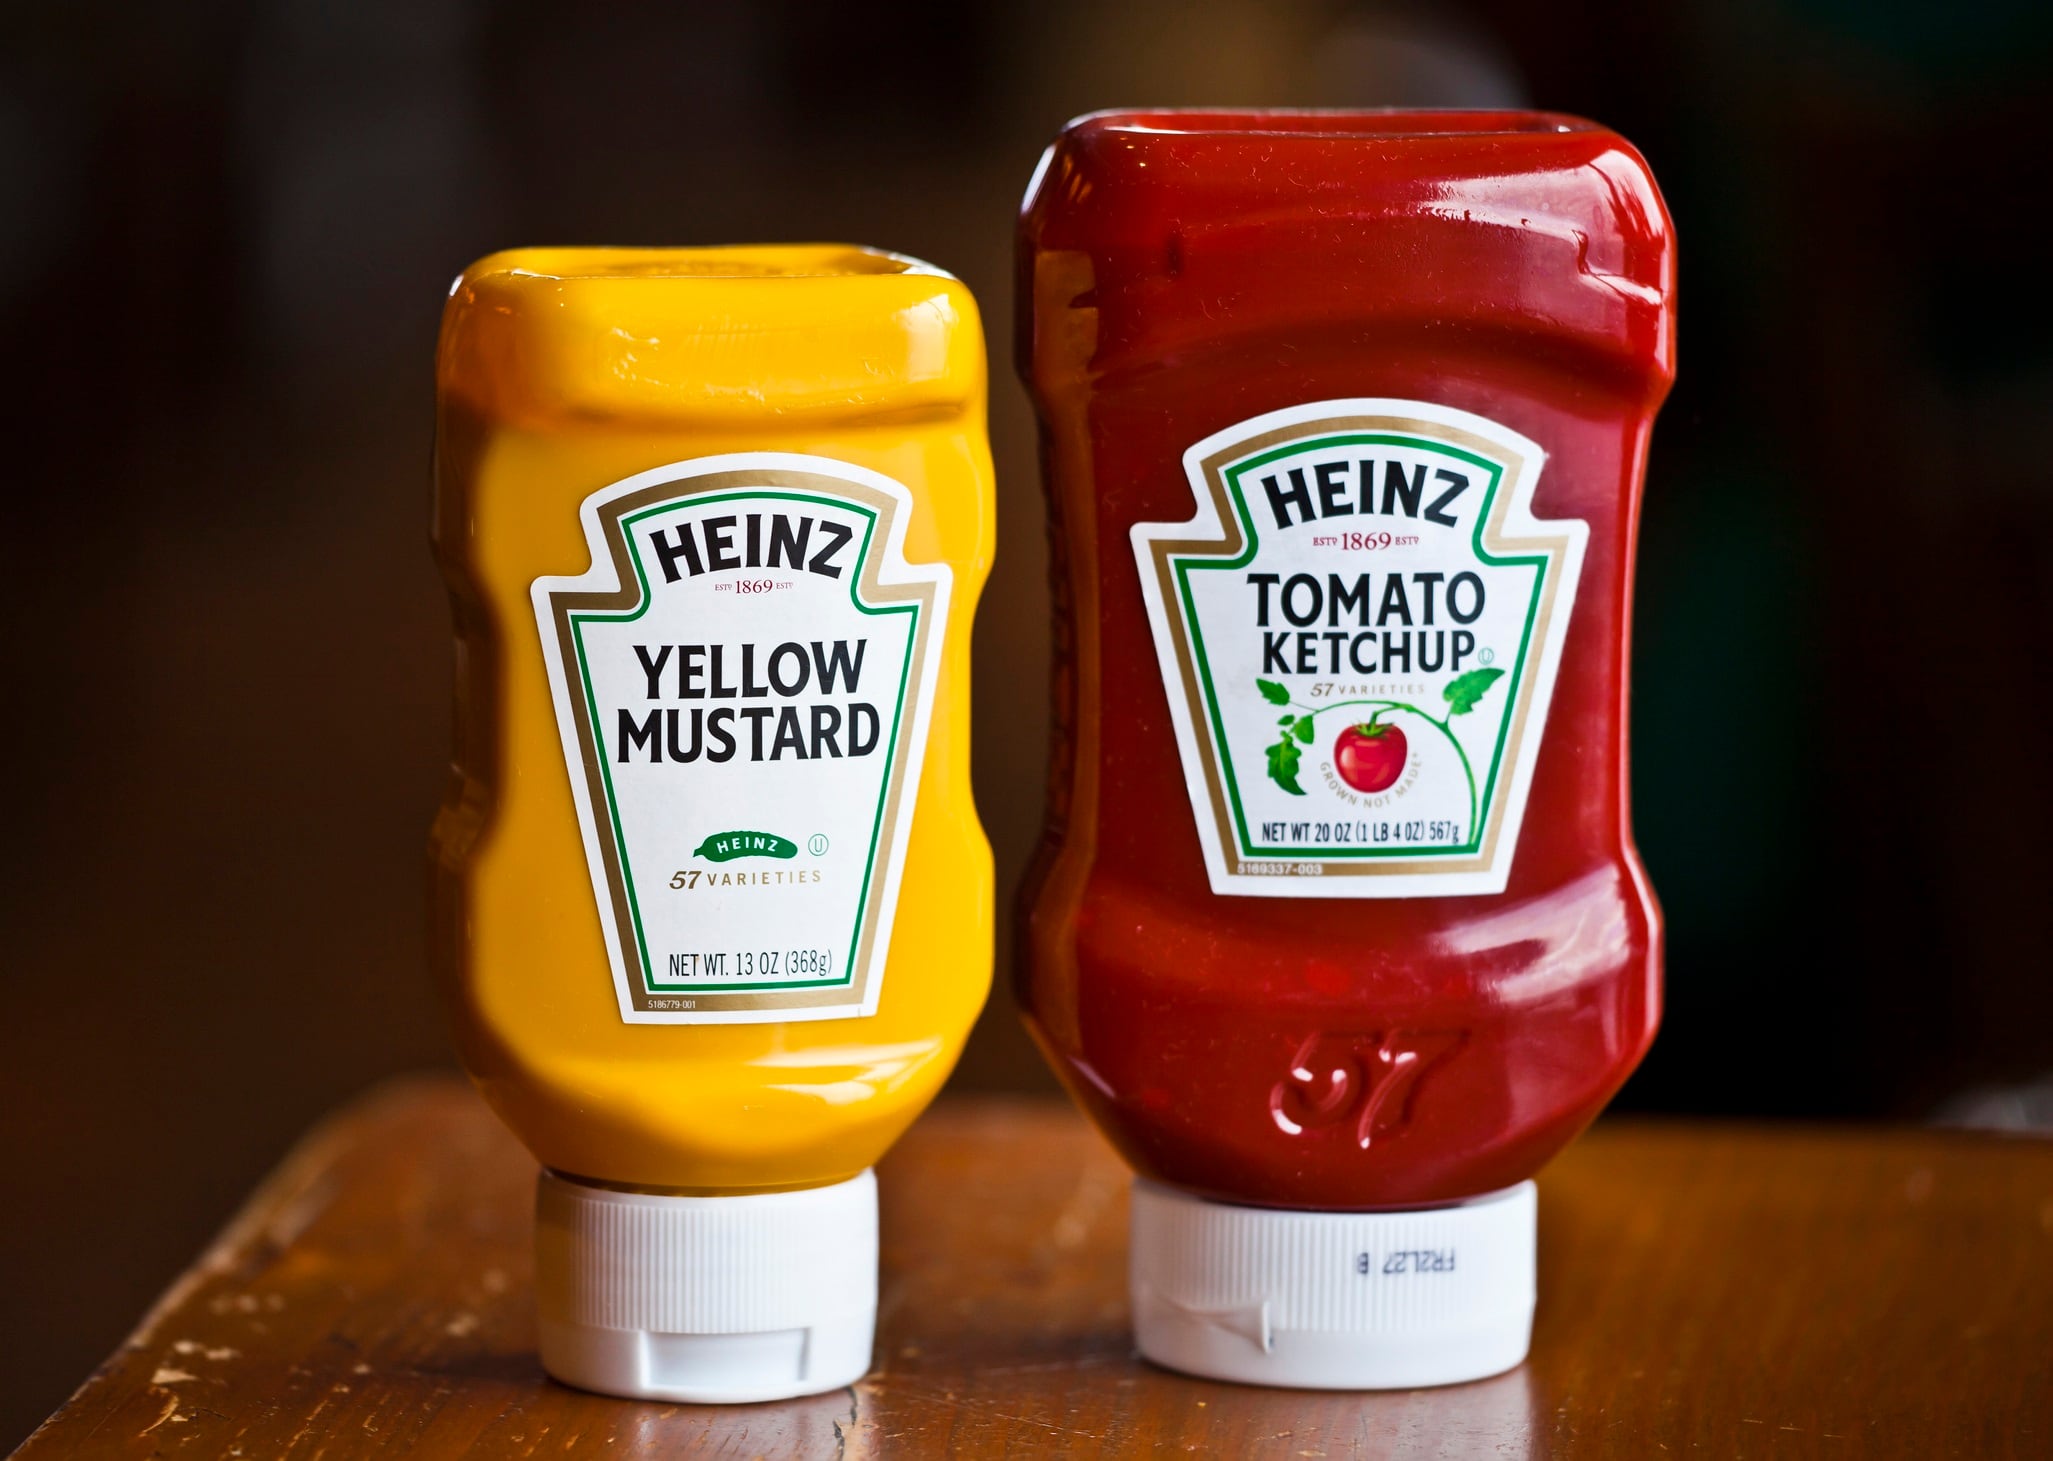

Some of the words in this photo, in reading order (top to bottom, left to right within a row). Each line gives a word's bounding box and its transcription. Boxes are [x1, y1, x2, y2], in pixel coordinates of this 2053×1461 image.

[1261, 460, 1470, 530] HEINZ
[649, 514, 853, 584] HEINZ
[1340, 532, 1392, 551] 1869
[735, 579, 774, 595] 1869
[1246, 571, 1486, 628] TOMATO
[633, 638, 868, 700] YELLOW
[1262, 630, 1476, 675] KETCHUP
[1310, 682, 1335, 698] 57
[1338, 682, 1425, 695] VARIETIES
[617, 702, 881, 764] MUSTARD
[1319, 761, 1359, 807] GROWN
[1362, 794, 1392, 809] NOT
[716, 836, 779, 854] HEINZ
[1262, 822, 1287, 842] NET
[1290, 822, 1310, 842] WT
[1314, 822, 1330, 842] 20
[1334, 822, 1351, 842] OZ
[1355, 820, 1368, 843] (1
[1373, 822, 1389, 842] LB
[1393, 821, 1401, 842] 4
[1405, 819, 1425, 842] OZ)
[1429, 820, 1459, 845] 567g
[669, 870, 702, 890] 57
[707, 869, 822, 887] VARIETIES
[669, 953, 699, 977] NET
[703, 953, 729, 977] WT.
[736, 952, 754, 976] 13
[759, 951, 780, 975] OZ
[785, 949, 832, 977] (368g)
[1268, 1026, 1473, 1150] 57
